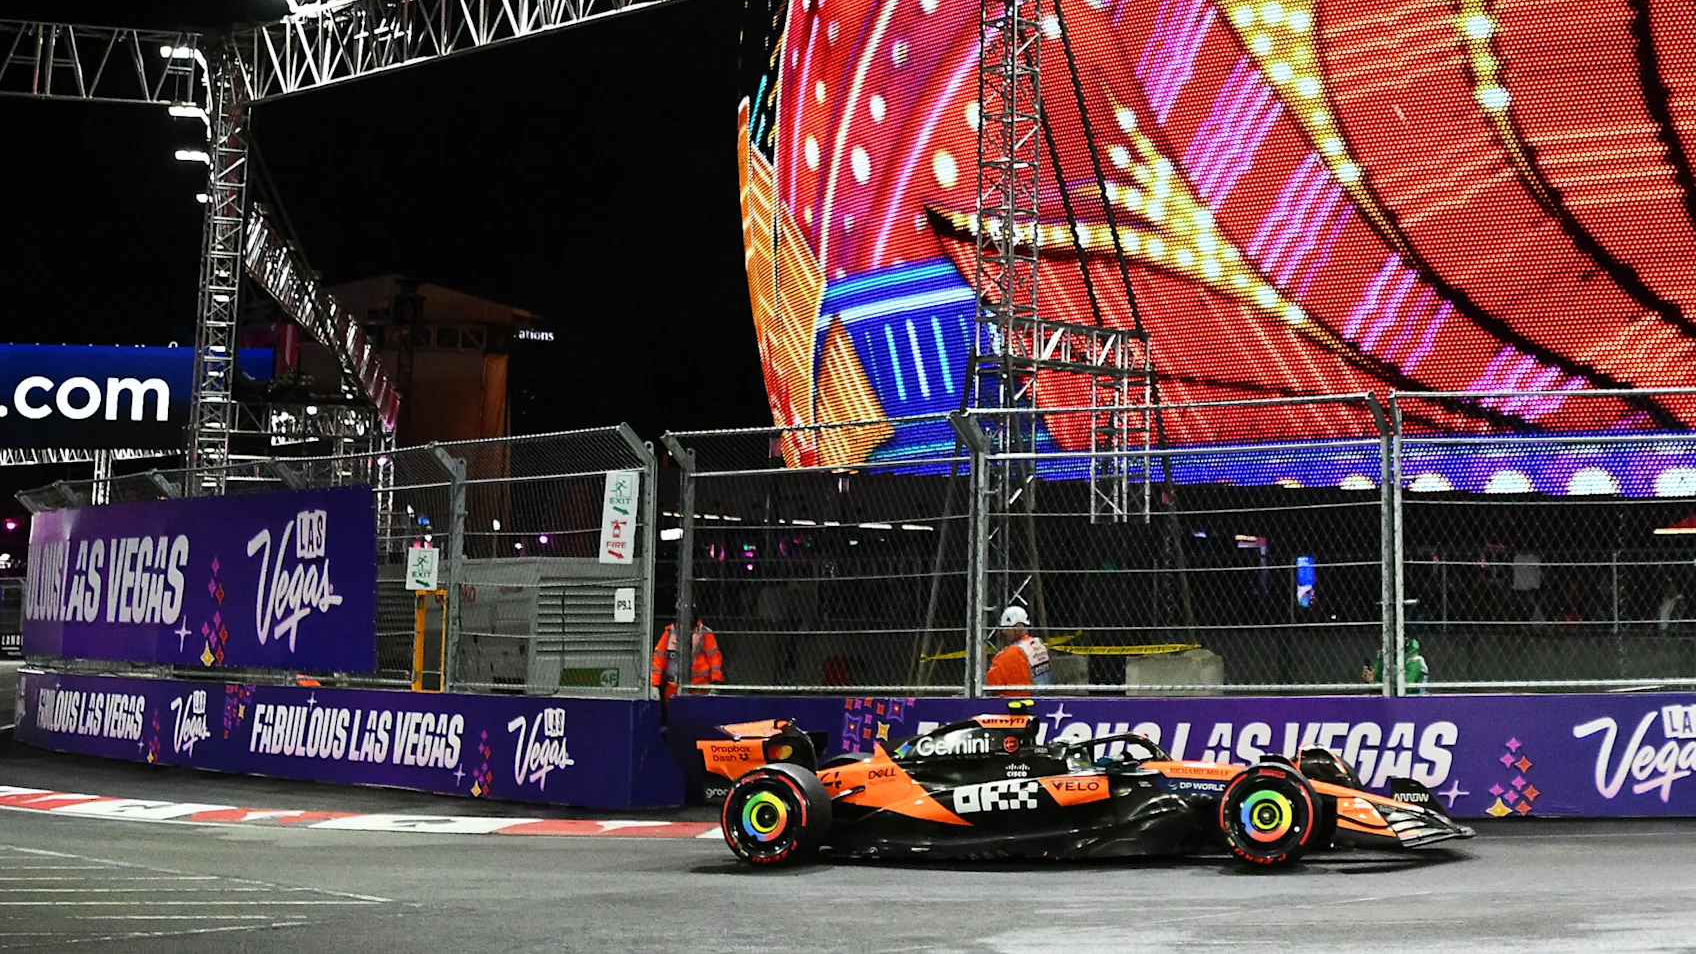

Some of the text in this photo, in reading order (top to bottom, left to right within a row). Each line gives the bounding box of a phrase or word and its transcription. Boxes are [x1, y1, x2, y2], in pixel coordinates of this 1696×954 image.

[0, 375, 170, 422] .com
[609, 497, 632, 505] EXIT
[299, 512, 325, 555] LAS
[606, 541, 627, 549] FIRE
[60, 533, 105, 623] LAS
[106, 534, 189, 625] VEGAS
[247, 520, 342, 654] Vegas
[78, 692, 105, 736] LAS
[103, 694, 145, 741] VEGAS
[170, 692, 211, 758] Vegas
[545, 709, 564, 735] LAS
[250, 703, 464, 769] FABULOUS LAS VEGAS
[916, 732, 990, 757] Gemini
[507, 712, 575, 791] Vegas
[710, 745, 751, 754] Dropbox
[712, 754, 737, 762] Dash
[868, 767, 897, 780] DELL
[1006, 770, 1028, 778] cisco
[1179, 781, 1193, 790] DP
[1052, 781, 1100, 792] VELO
